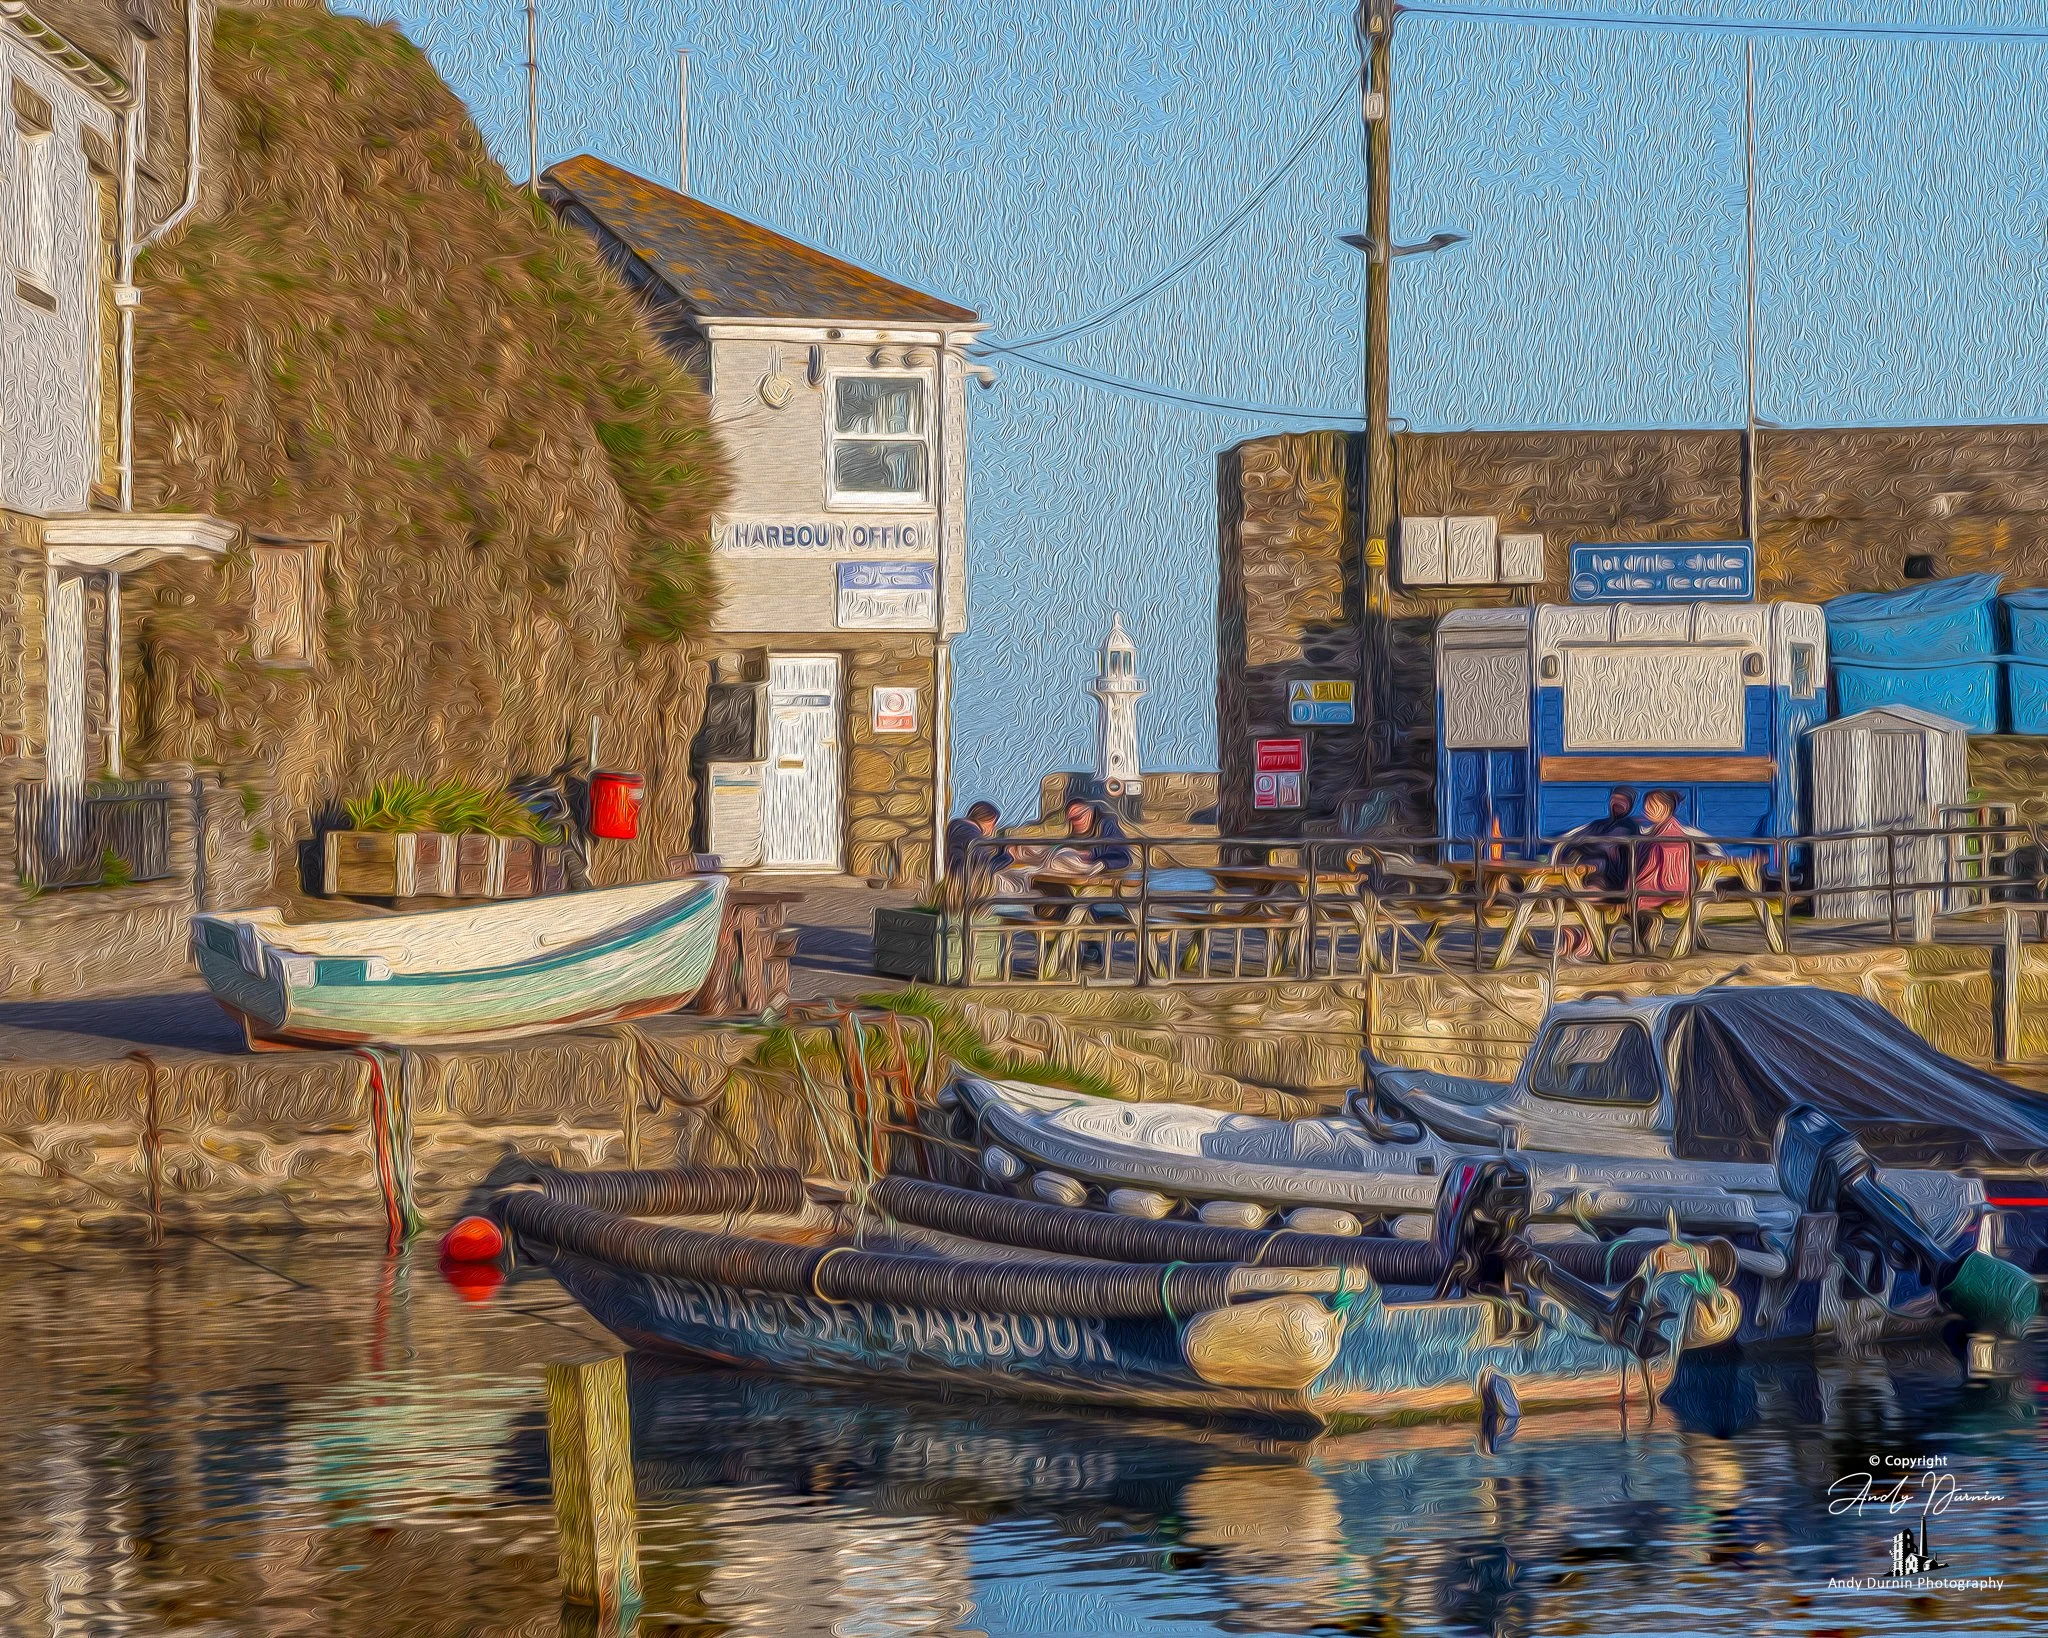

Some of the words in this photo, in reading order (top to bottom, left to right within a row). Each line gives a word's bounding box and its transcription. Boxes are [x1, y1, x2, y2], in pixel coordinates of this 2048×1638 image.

[734, 525, 846, 548] HARBOUR
[852, 525, 931, 548] OFFIC
[887, 1303, 1115, 1361] HARBOUR
